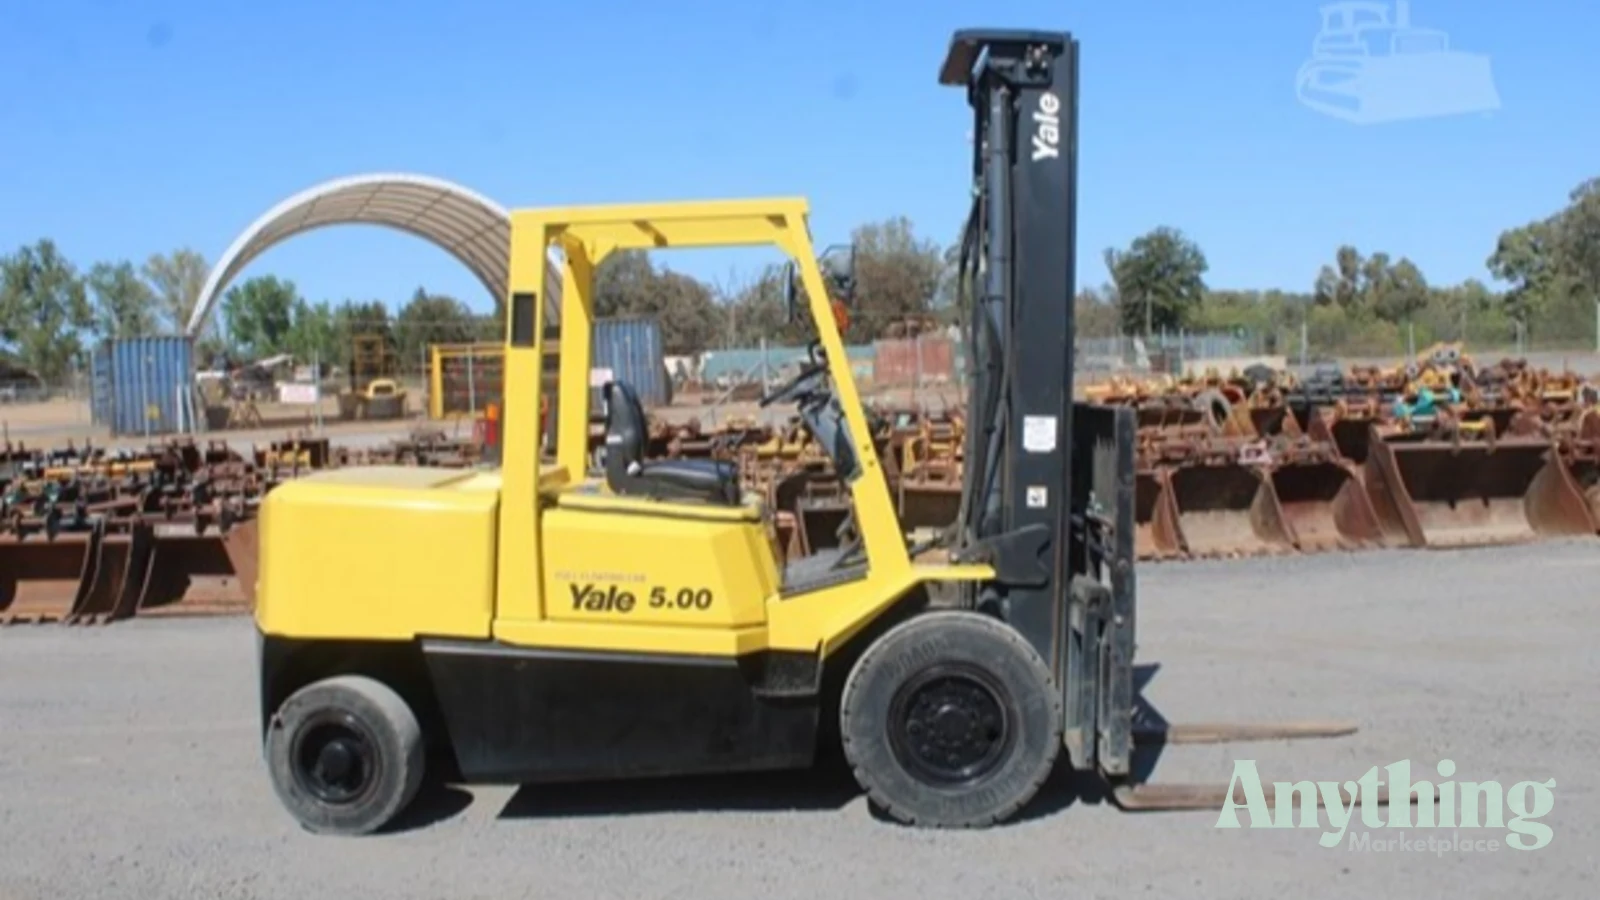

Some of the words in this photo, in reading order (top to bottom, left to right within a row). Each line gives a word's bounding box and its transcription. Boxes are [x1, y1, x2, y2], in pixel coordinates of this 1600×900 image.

[1032, 92, 1059, 161] Yale
[570, 584, 636, 613] Yale
[649, 586, 713, 610] 5.00
